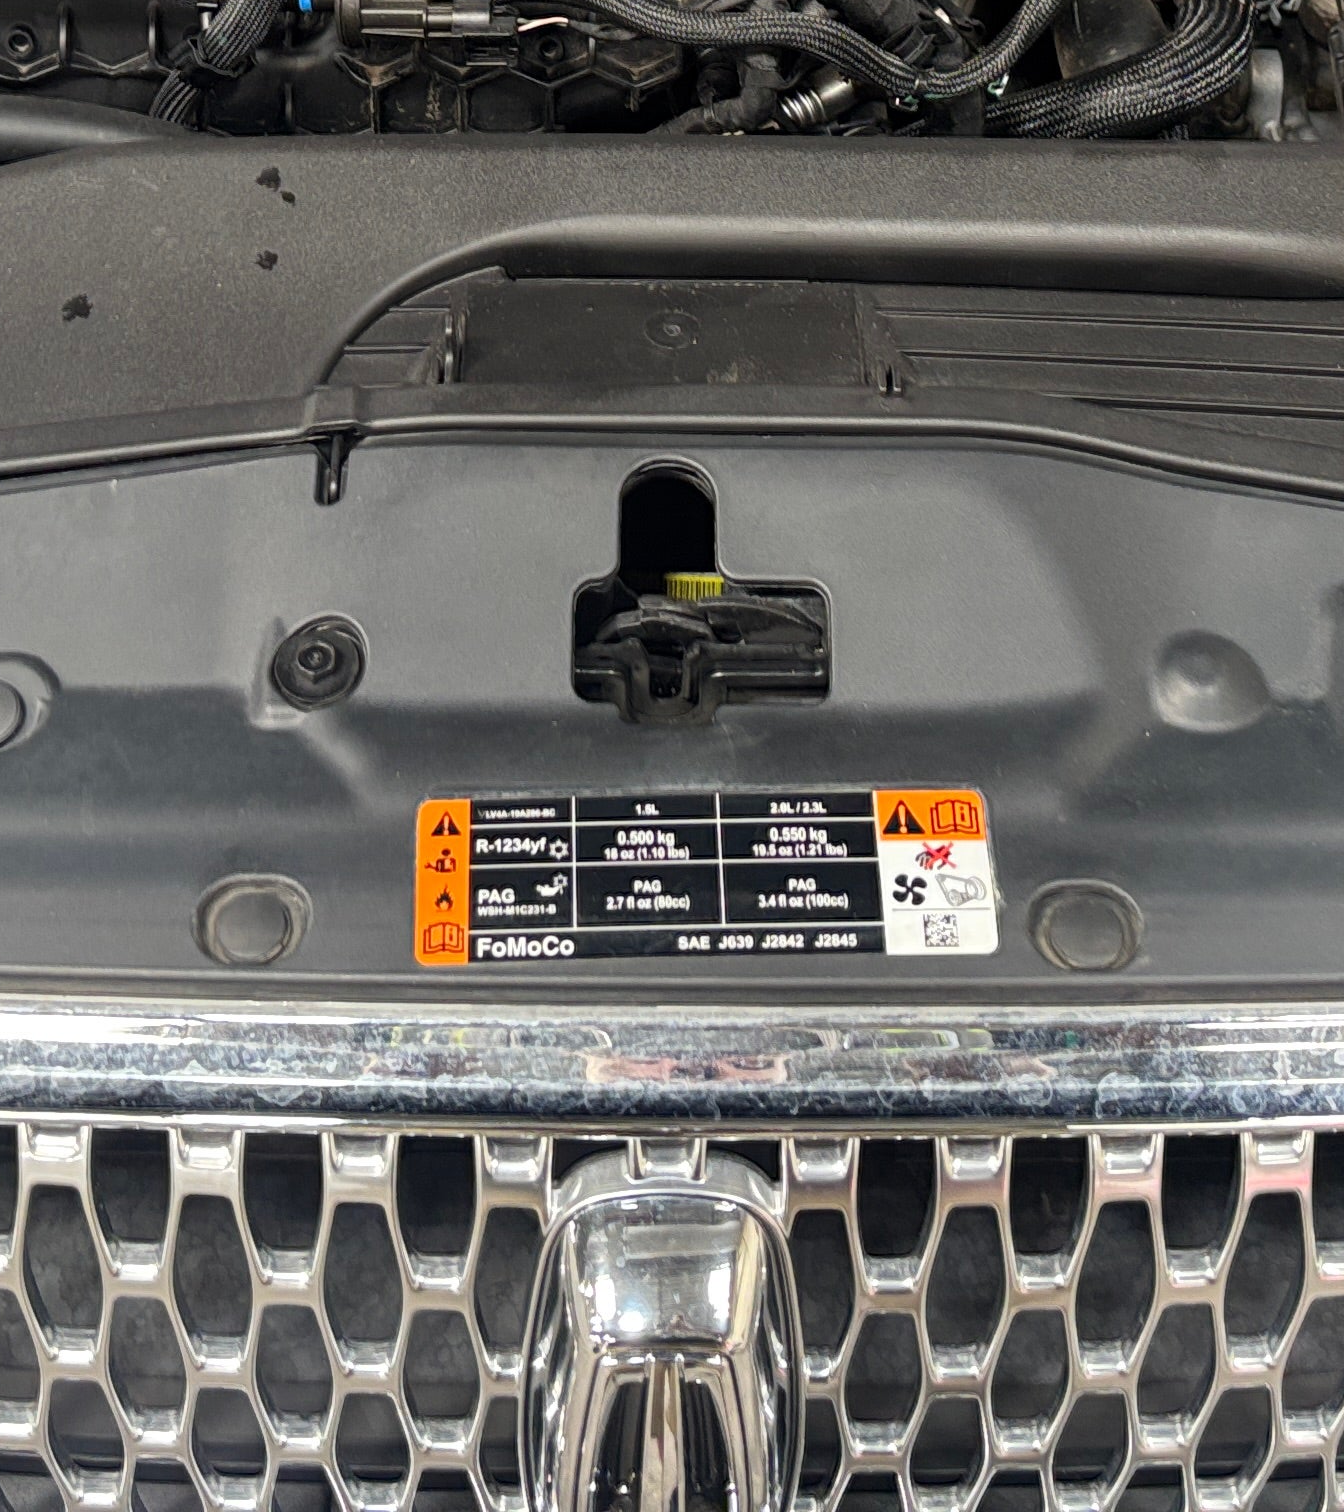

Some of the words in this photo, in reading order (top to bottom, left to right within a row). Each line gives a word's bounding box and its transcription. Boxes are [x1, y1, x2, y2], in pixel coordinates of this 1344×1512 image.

[770, 801, 794, 814] 2.0L
[802, 801, 827, 813] 2.3L
[617, 830, 654, 846] 0.500
[657, 830, 675, 847] kg
[769, 827, 806, 842] 0.550
[809, 827, 827, 844] kg
[475, 836, 547, 856] R-1234yf
[620, 849, 635, 860] oz
[637, 846, 665, 861] (1.10
[668, 846, 690, 860] lbs)
[778, 845, 793, 856] oz
[795, 843, 822, 857] (1.21
[825, 843, 848, 857] lbs)
[633, 880, 662, 893] PAG
[788, 878, 816, 892] PAG
[478, 888, 515, 904] PAG
[606, 896, 624, 910] 2.7
[626, 895, 635, 909] fl
[637, 898, 652, 909] oz
[758, 894, 776, 908] 3.4
[778, 893, 787, 907] fl
[789, 896, 803, 907] oz
[806, 892, 849, 910] (100cc)
[477, 935, 575, 958] FoMoCo
[677, 935, 711, 950] SAE
[718, 934, 754, 950] J639
[761, 933, 805, 949] J2842
[814, 932, 858, 948] J2845
